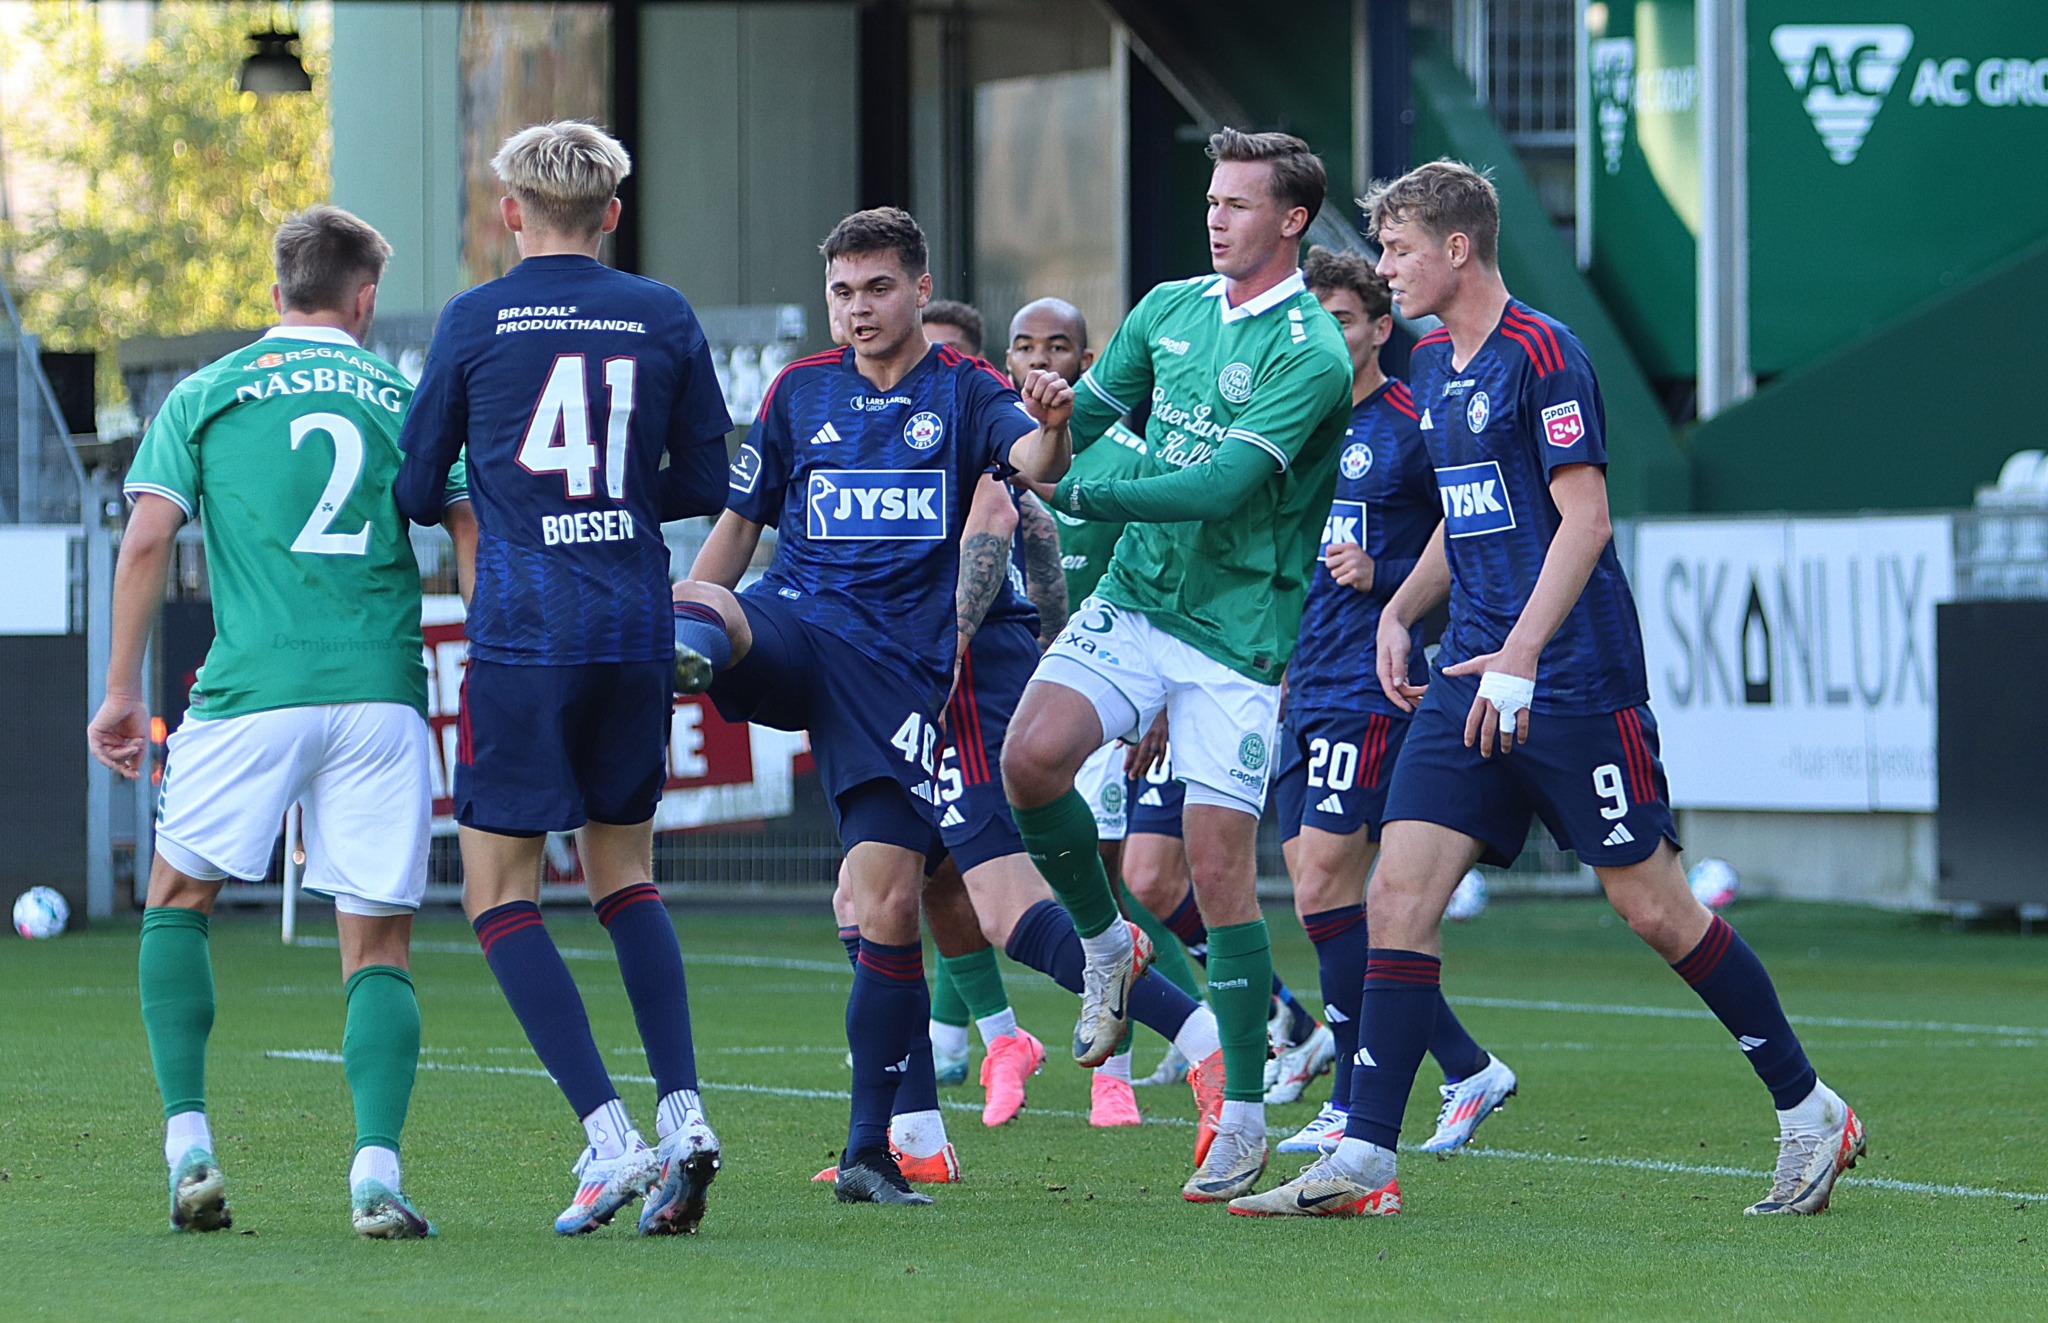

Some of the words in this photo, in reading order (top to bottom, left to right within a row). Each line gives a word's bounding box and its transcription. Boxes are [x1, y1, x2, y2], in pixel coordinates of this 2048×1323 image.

[1909, 57, 1971, 107] AC
[496, 319, 646, 335] PRODUKTHANDEL
[236, 367, 402, 413] NÄSBERG
[866, 397, 885, 405] LARS
[886, 396, 912, 405] LARSEN
[1151, 386, 1190, 426] Peter
[514, 353, 637, 502] 41
[1184, 404, 1228, 442] Lars
[1544, 403, 1576, 420] SPORT
[1551, 419, 1580, 441] 24
[1156, 430, 1218, 467] Kaff
[290, 412, 371, 556] 2
[833, 487, 938, 521] JYSK
[1439, 479, 1504, 519] JYSK
[541, 510, 634, 546] BOESEN
[1320, 516, 1359, 545] SK
[891, 711, 937, 777] 40
[1308, 737, 1358, 791] 20
[933, 746, 964, 806] 5
[1592, 763, 1629, 820] 9
